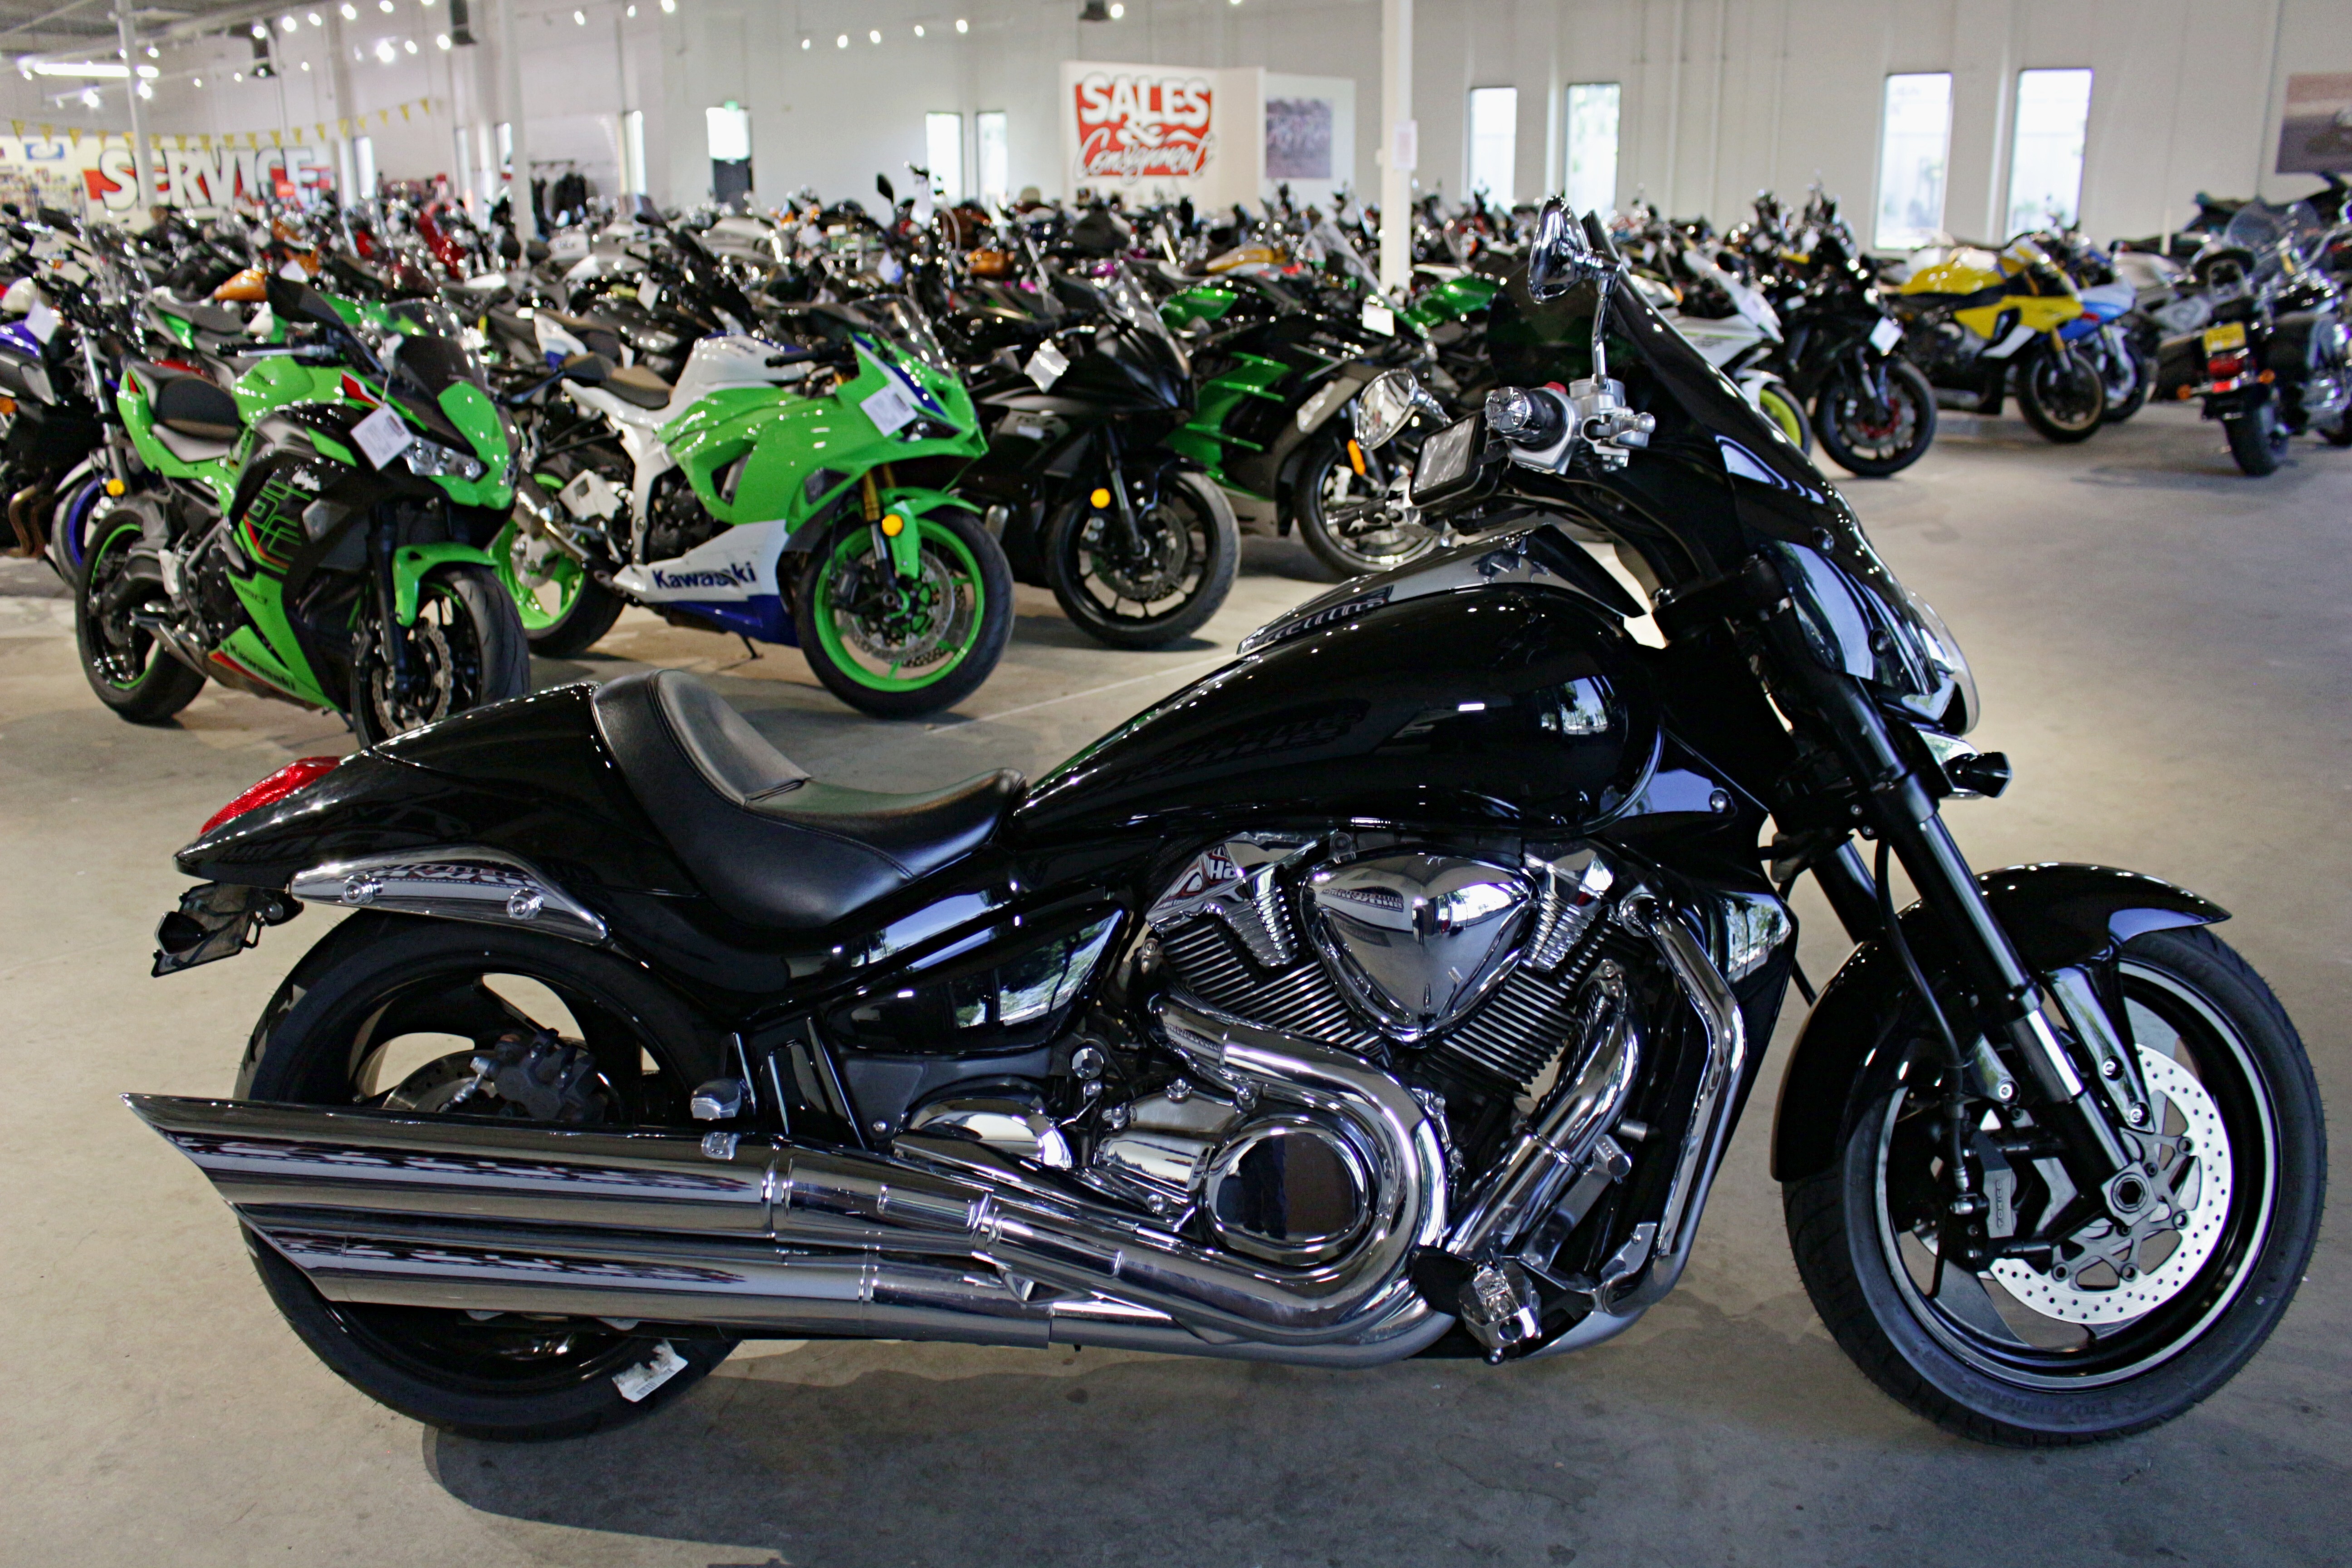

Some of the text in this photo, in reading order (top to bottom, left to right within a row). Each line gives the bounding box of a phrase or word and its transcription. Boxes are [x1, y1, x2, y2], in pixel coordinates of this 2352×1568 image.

[1079, 71, 1211, 128] SALES
[1074, 127, 1216, 184] Consignment
[1115, 119, 1168, 148] &
[98, 145, 320, 211] SERVICE
